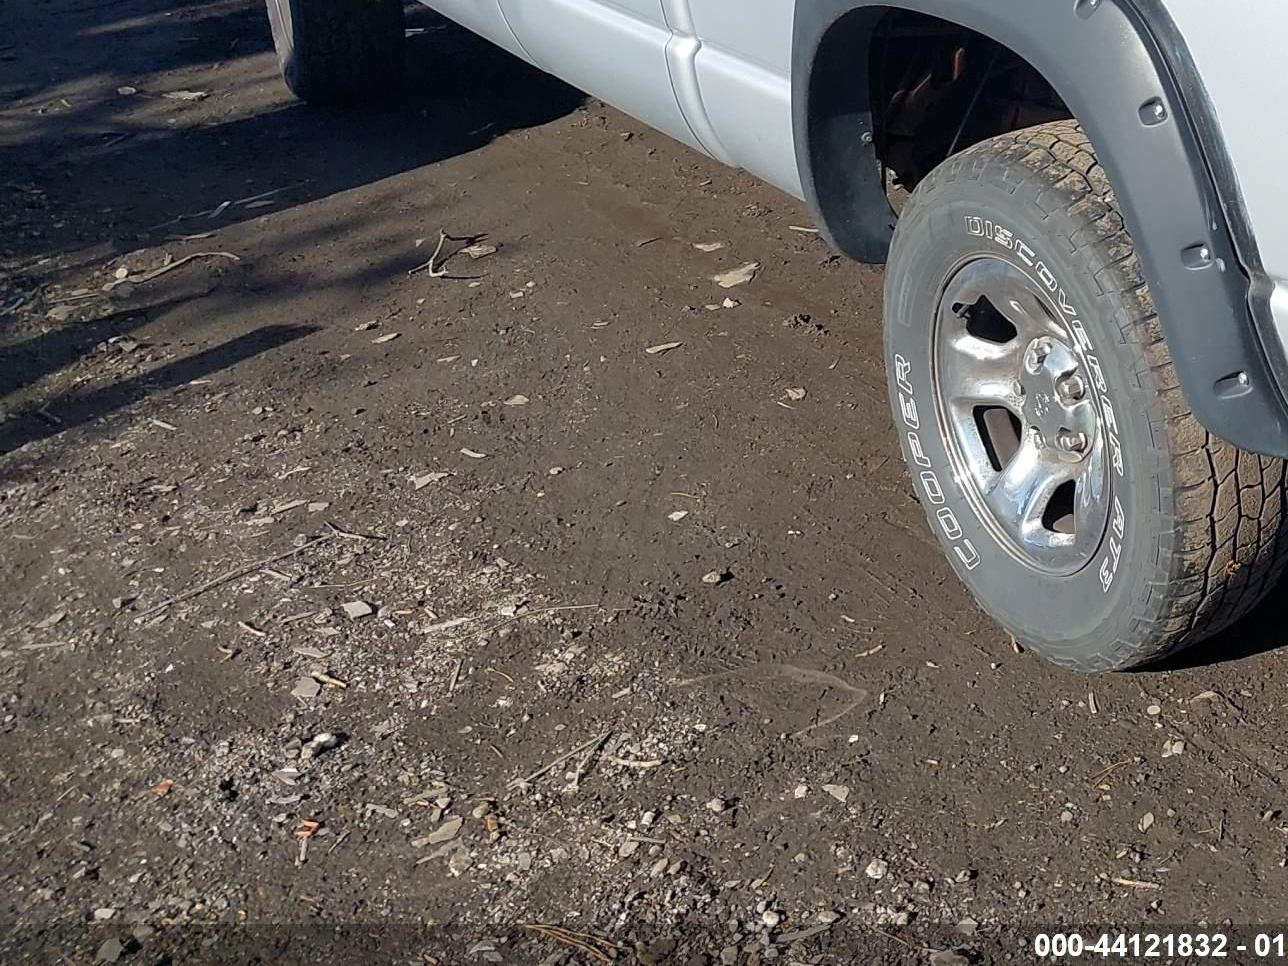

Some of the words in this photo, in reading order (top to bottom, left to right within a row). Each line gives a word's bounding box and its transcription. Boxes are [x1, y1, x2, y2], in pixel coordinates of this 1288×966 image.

[895, 353, 981, 570] COOPER
[965, 215, 1122, 477] DISCOVERER
[1100, 495, 1125, 593] AT3
